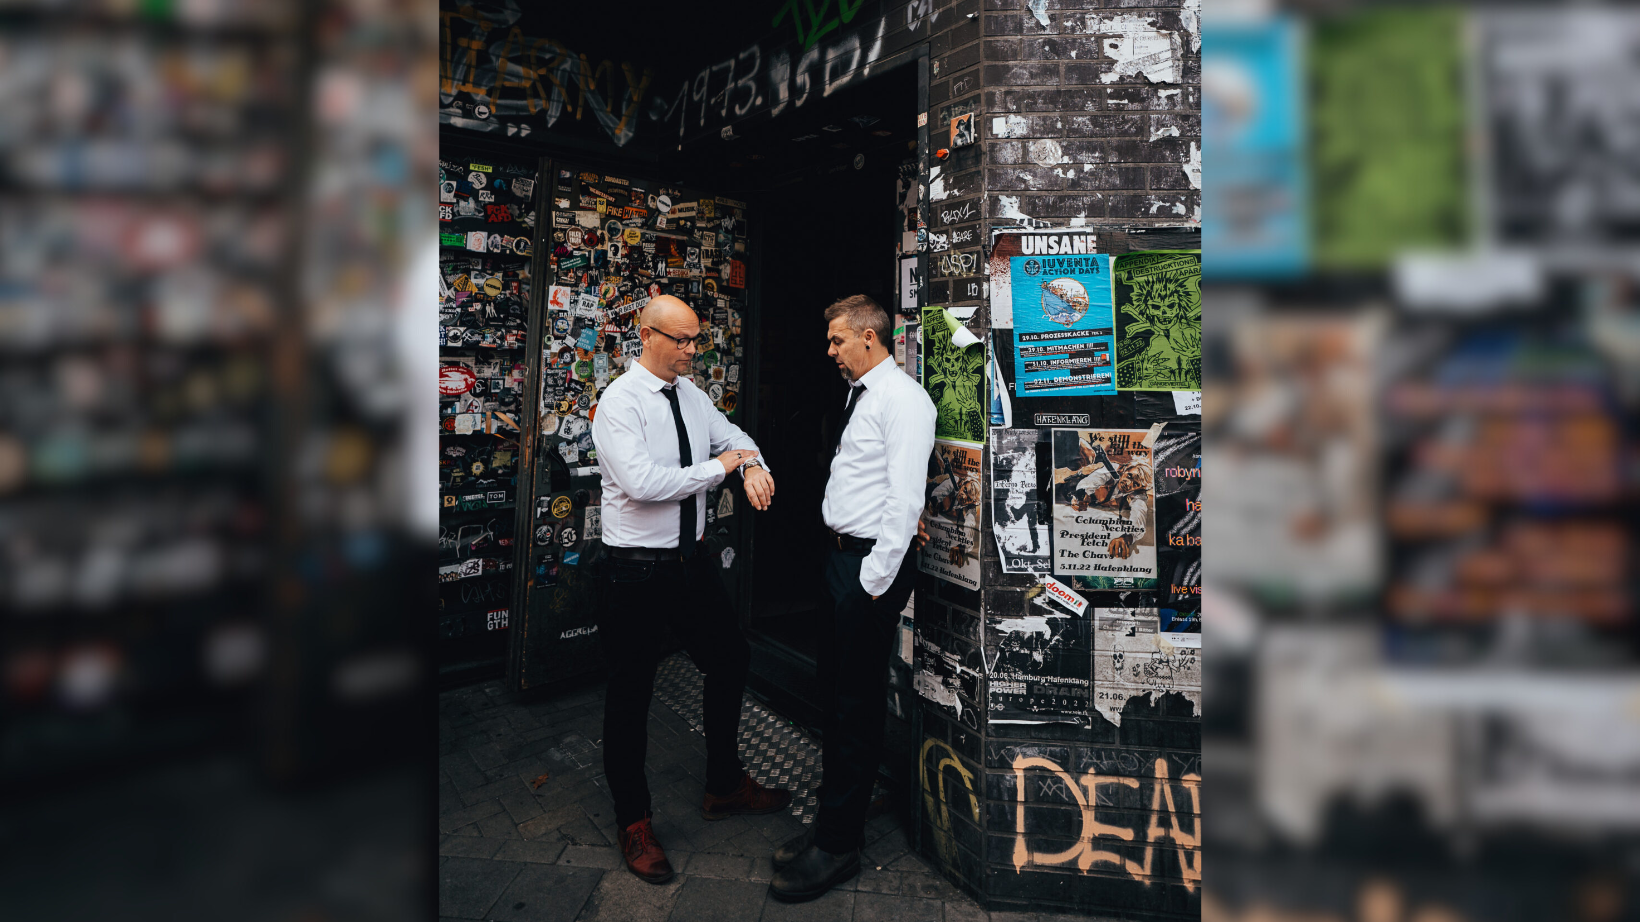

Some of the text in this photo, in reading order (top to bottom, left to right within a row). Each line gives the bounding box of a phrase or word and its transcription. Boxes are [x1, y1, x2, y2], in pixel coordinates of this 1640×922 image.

[606, 205, 624, 217] FIRE
[1021, 235, 1098, 255] UNSANE
[1042, 256, 1099, 270] IUVENTA
[1119, 256, 1157, 270] APPENDIX
[1135, 258, 1195, 276] DESTRUCKTIONS
[1042, 266, 1101, 277] ACTION DAYS
[1040, 330, 1090, 341] PROZESSKACKE
[1046, 343, 1085, 352] MITMACHEN
[1049, 357, 1092, 366] INFORMIEREN
[1036, 414, 1089, 425] HAFENKLANG
[1087, 432, 1131, 446] We still
[1126, 449, 1150, 458] way
[1165, 465, 1202, 480] robyn
[1101, 524, 1145, 533] Neckties
[1059, 529, 1111, 541] President
[1169, 534, 1185, 547] ka
[1080, 538, 1108, 547] Fetch
[1058, 549, 1114, 560] The Chavs
[1059, 563, 1152, 575] 5.11.22 Hafenklang
[1170, 584, 1188, 594] live
[487, 609, 509, 621] FUN
[487, 618, 509, 631] GTH
[1012, 672, 1046, 684] Hamburg
[1047, 674, 1089, 688] Hafenklang
[989, 680, 1090, 698] HIGHER DRAIN
[989, 687, 1027, 696] POWER
[1098, 691, 1126, 701] 21.06.
